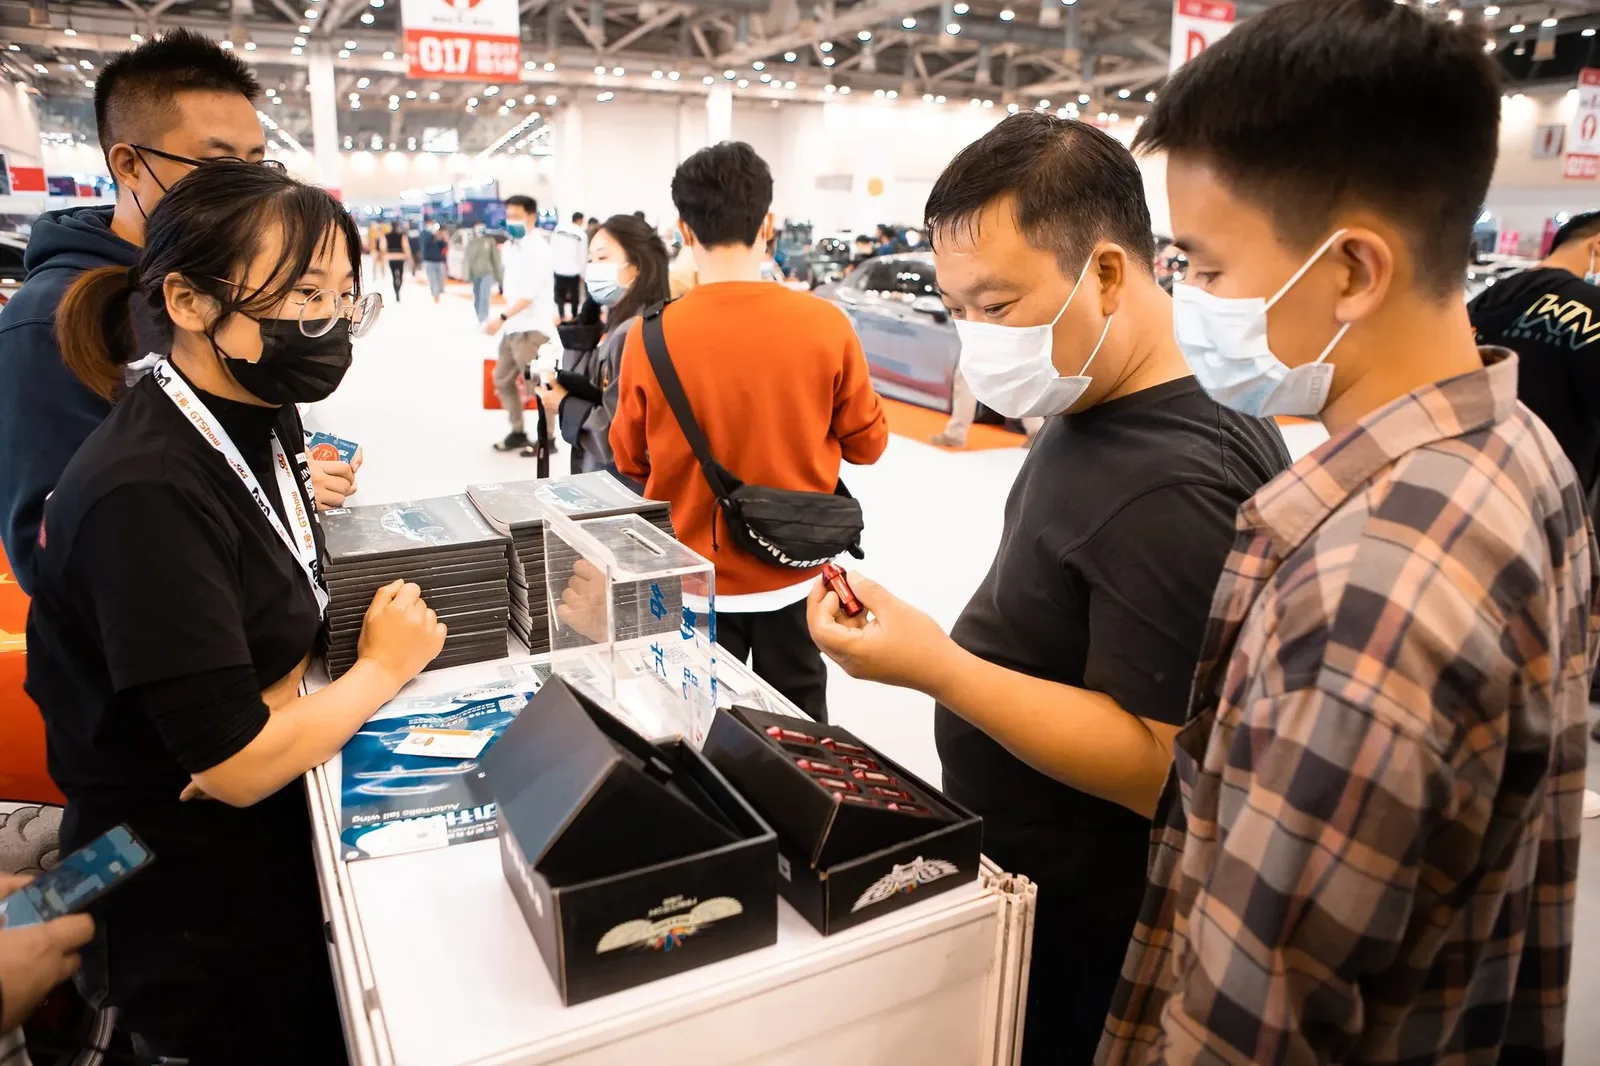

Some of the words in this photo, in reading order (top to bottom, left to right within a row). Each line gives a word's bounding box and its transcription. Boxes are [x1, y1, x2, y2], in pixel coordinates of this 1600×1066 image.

[189, 411, 222, 447] GTShow
[291, 491, 308, 528] GTShow
[352, 814, 381, 823] wing
